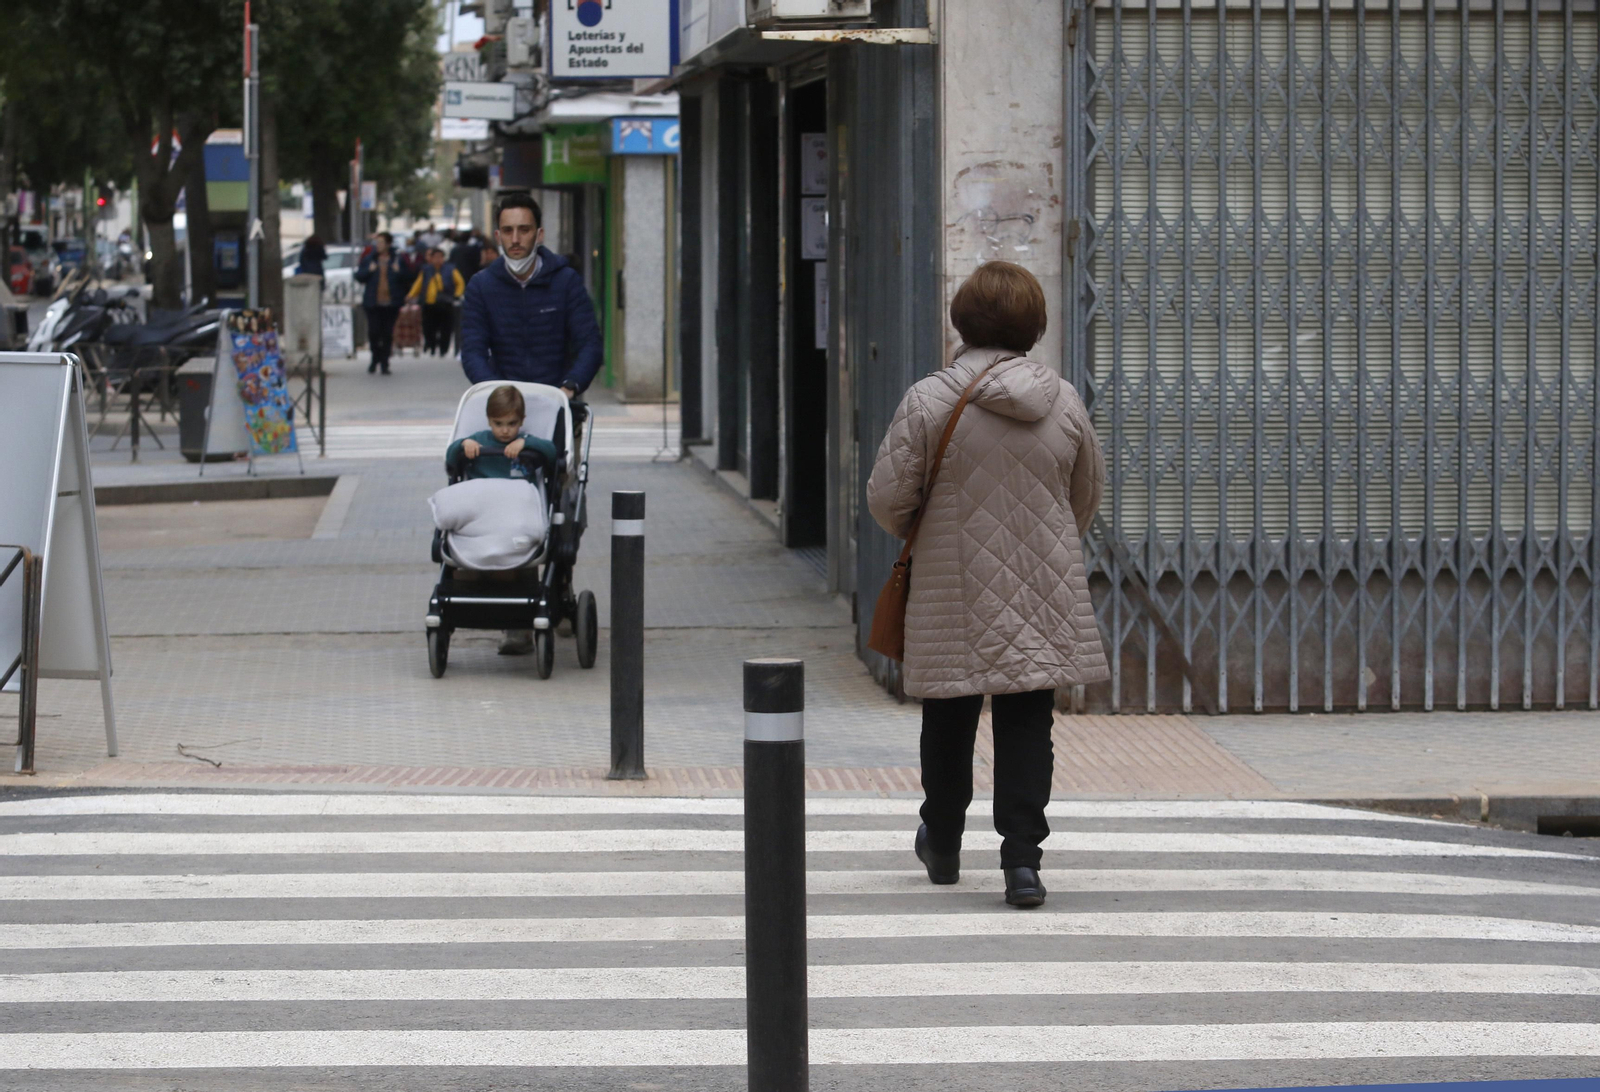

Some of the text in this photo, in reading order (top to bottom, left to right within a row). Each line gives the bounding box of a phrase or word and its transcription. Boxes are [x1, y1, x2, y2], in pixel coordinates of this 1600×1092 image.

[568, 31, 627, 42] Loterías y
[569, 43, 644, 56] Apuestas del
[568, 58, 609, 68] Estado
